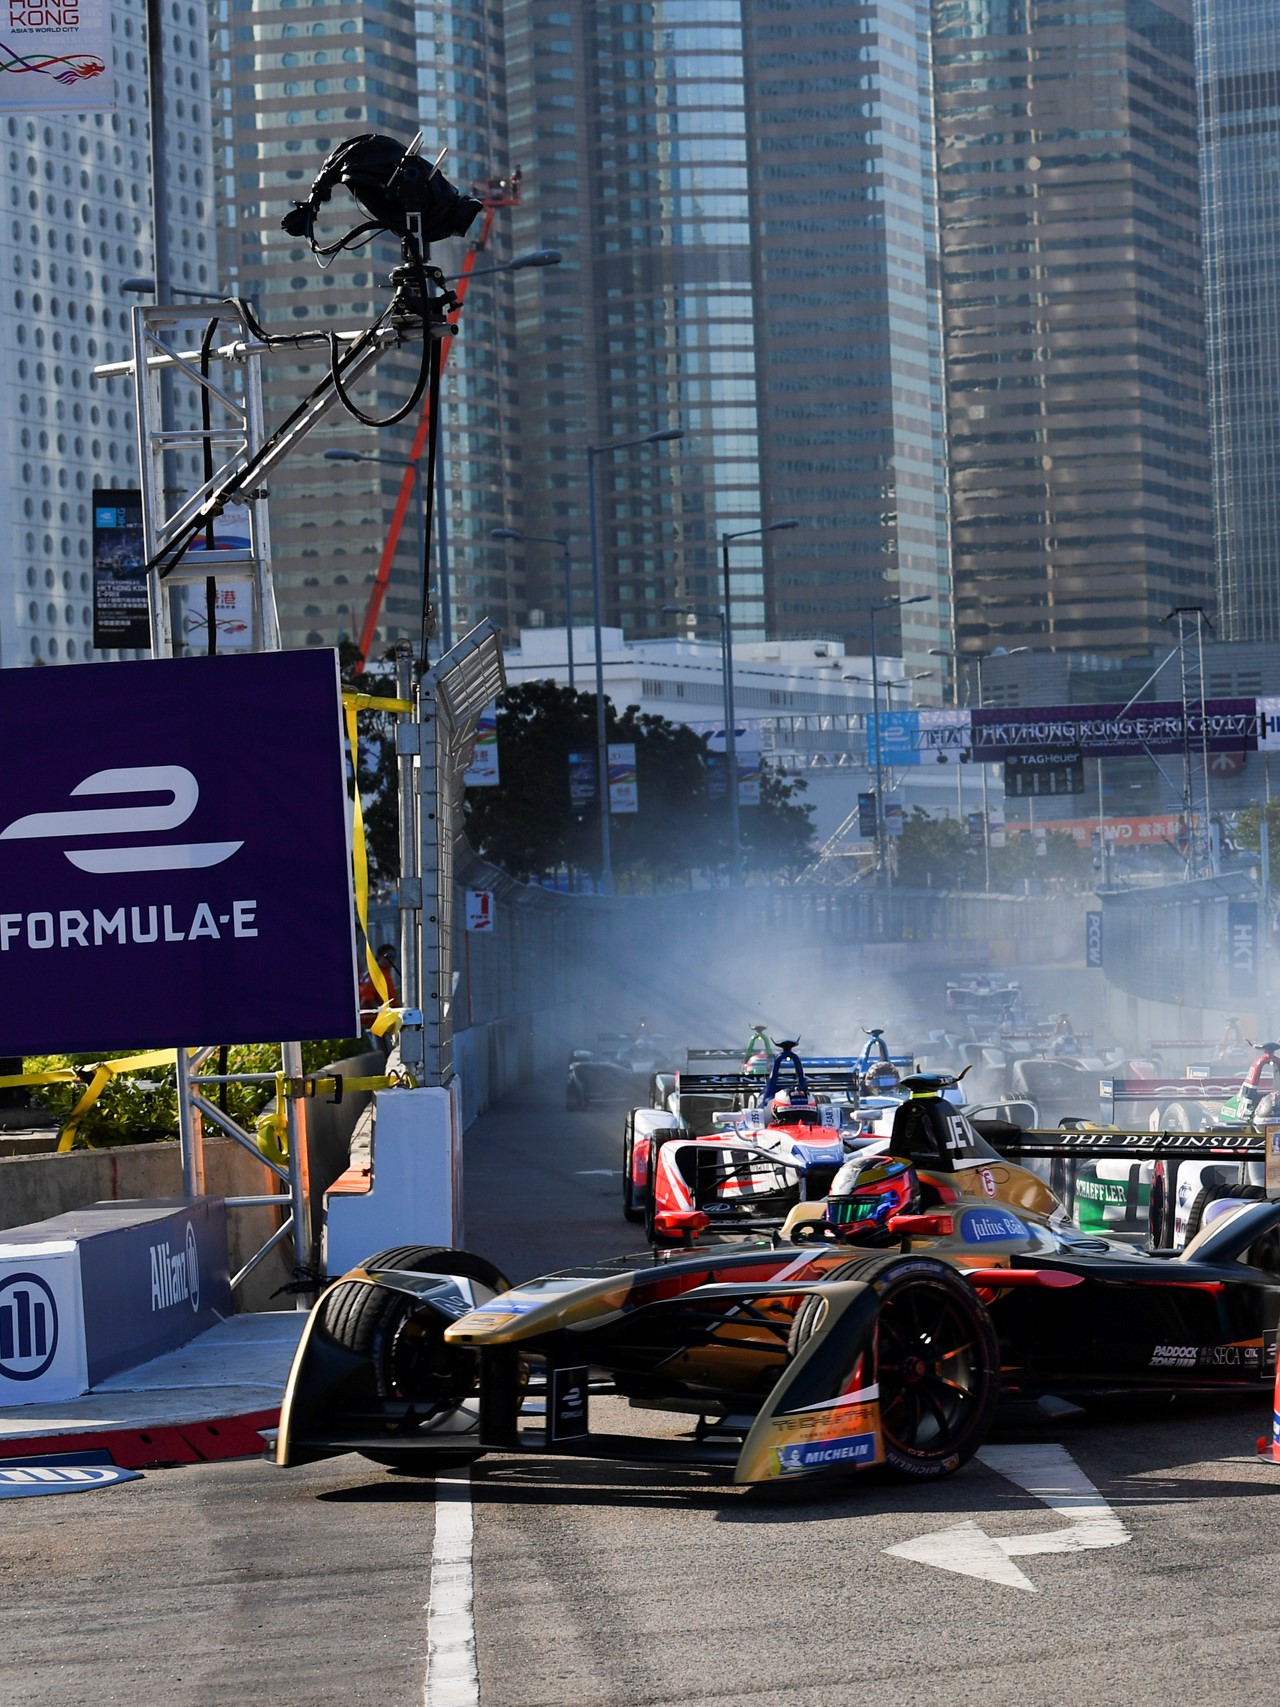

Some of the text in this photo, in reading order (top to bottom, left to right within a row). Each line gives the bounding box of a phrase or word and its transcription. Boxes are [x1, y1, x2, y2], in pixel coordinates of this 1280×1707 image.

[10, 9, 79, 26] KONG
[1089, 914, 1100, 964] PCCW
[1234, 925, 1252, 972] HKT
[946, 1115, 974, 1149] JEV
[1059, 1134, 1267, 1149] THE PENINSULA
[1076, 1178, 1127, 1203] SCHAEFFLER
[971, 1219, 1006, 1240] Julius
[149, 1242, 189, 1312] Allianz
[1153, 1345, 1199, 1358] PADDOCK
[1213, 1346, 1241, 1365] SECA
[805, 1444, 869, 1464] MICHELIN
